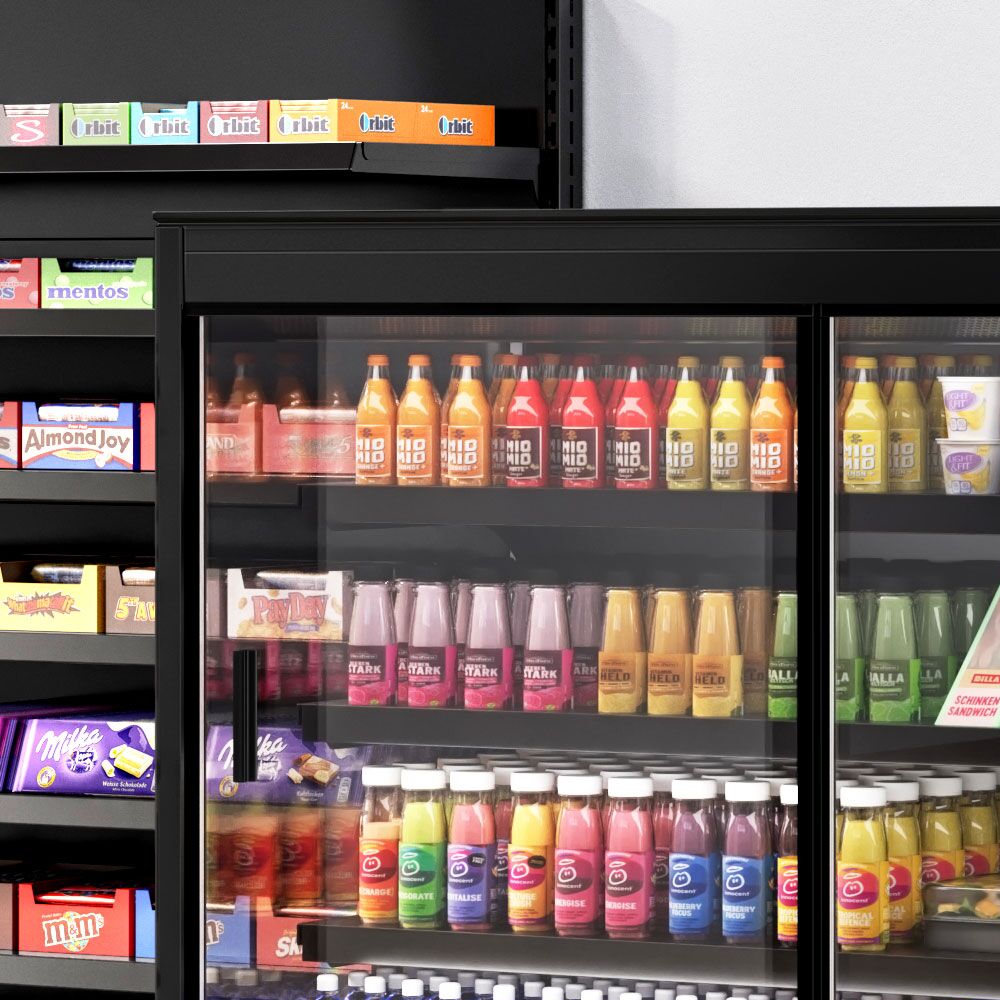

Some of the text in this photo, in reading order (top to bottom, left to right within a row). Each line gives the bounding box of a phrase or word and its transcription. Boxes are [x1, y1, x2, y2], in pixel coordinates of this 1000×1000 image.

[71, 115, 121, 138] Orbit
[139, 115, 190, 137] Orbit
[207, 114, 261, 137] Orbit
[278, 113, 330, 136] Orbit
[359, 112, 395, 133] Orbit
[438, 115, 473, 136] Orbit
[47, 284, 129, 299] mentos
[25, 429, 97, 453] Almond
[98, 430, 130, 453] Joy
[507, 440, 531, 452] MIO
[562, 440, 587, 453] MIO
[616, 441, 640, 454] MIO
[507, 452, 531, 465] MIO
[562, 453, 587, 466] MIO
[616, 454, 640, 467] MIO
[947, 706, 998, 718] SANDWICH
[38, 725, 104, 762] Milka
[218, 733, 287, 768] Mka
